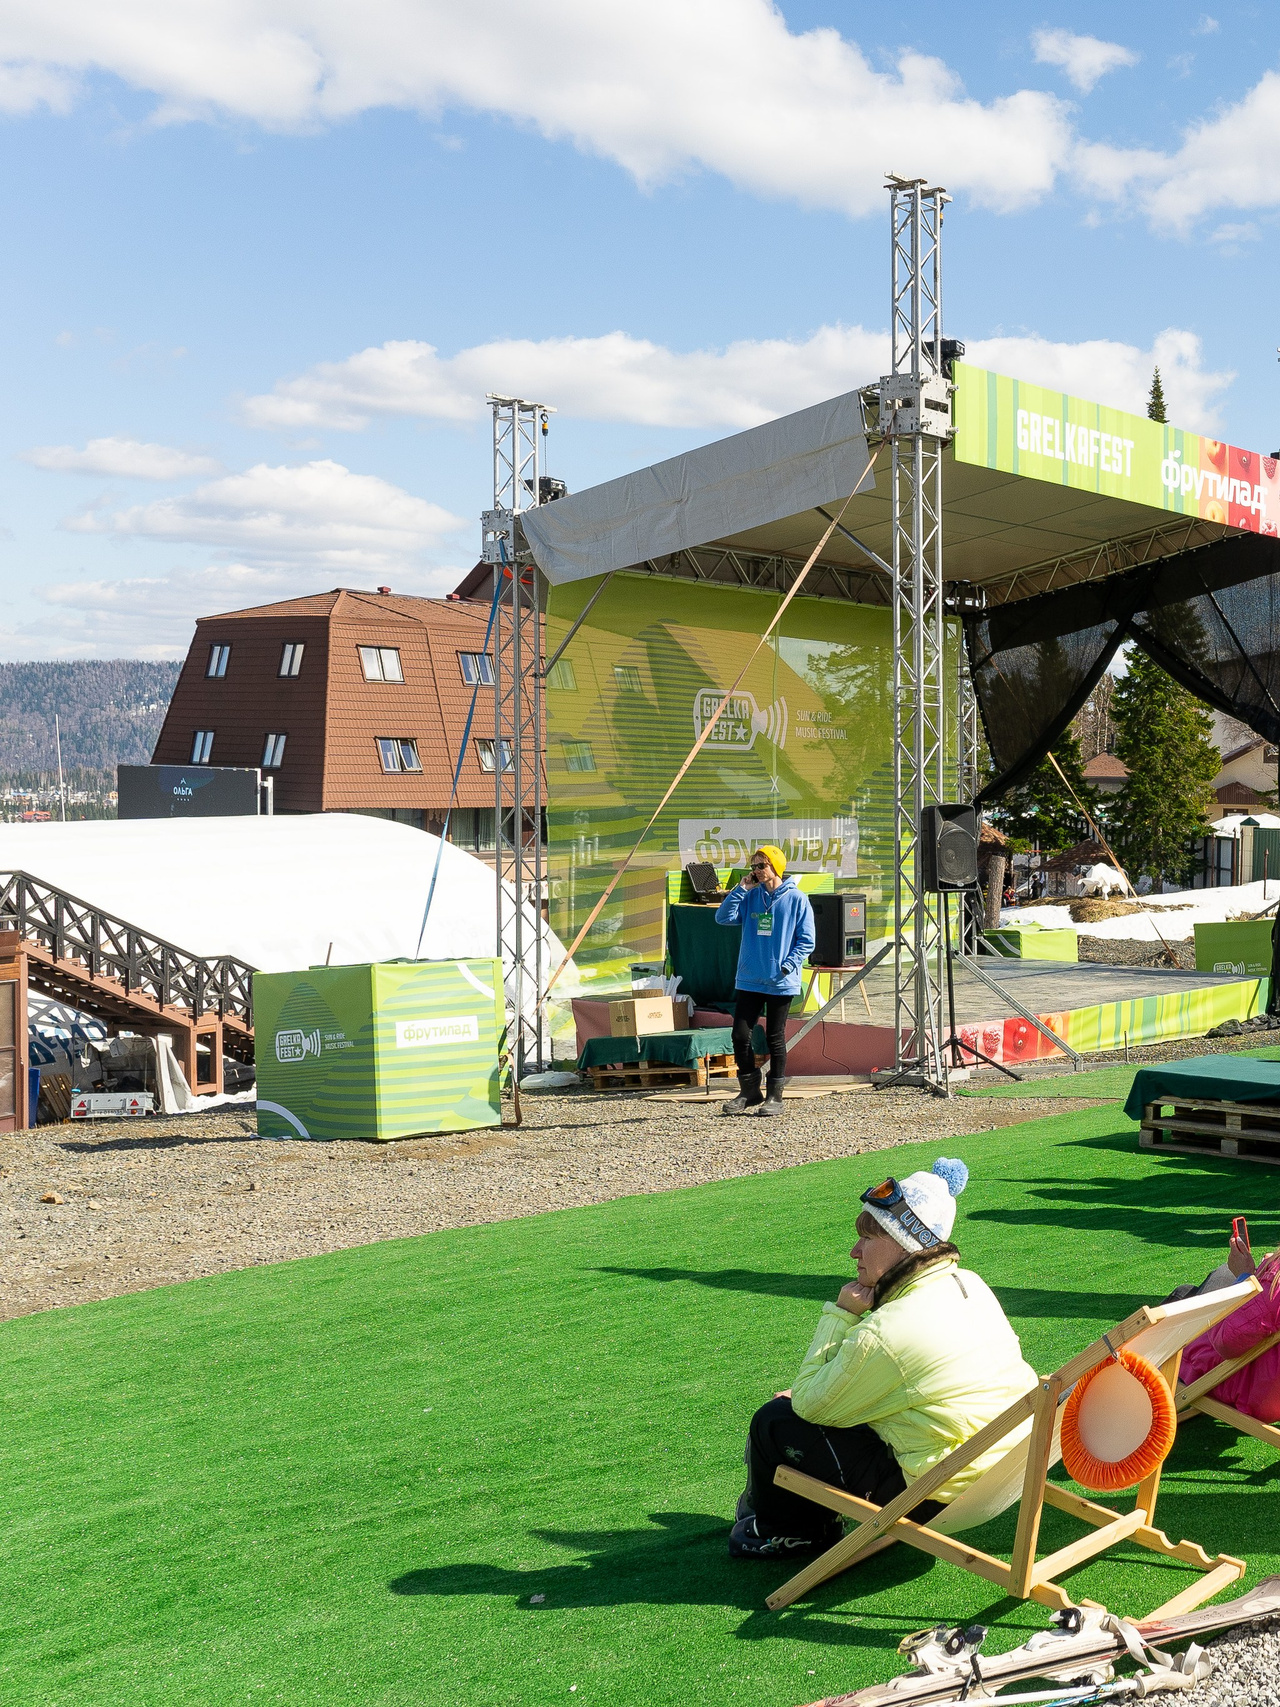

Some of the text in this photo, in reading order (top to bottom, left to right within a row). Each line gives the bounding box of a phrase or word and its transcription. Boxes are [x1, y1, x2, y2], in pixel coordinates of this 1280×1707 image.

[1016, 409, 1135, 478] GRELKAFEST
[796, 709, 810, 722] SUN
[817, 711, 832, 723] RIDE
[795, 726, 848, 740] MUSIC FESTIVAL
[172, 786, 193, 796] ОЛЬГА
[279, 1033, 302, 1047] GRELKA
[280, 1046, 295, 1058] FEST
